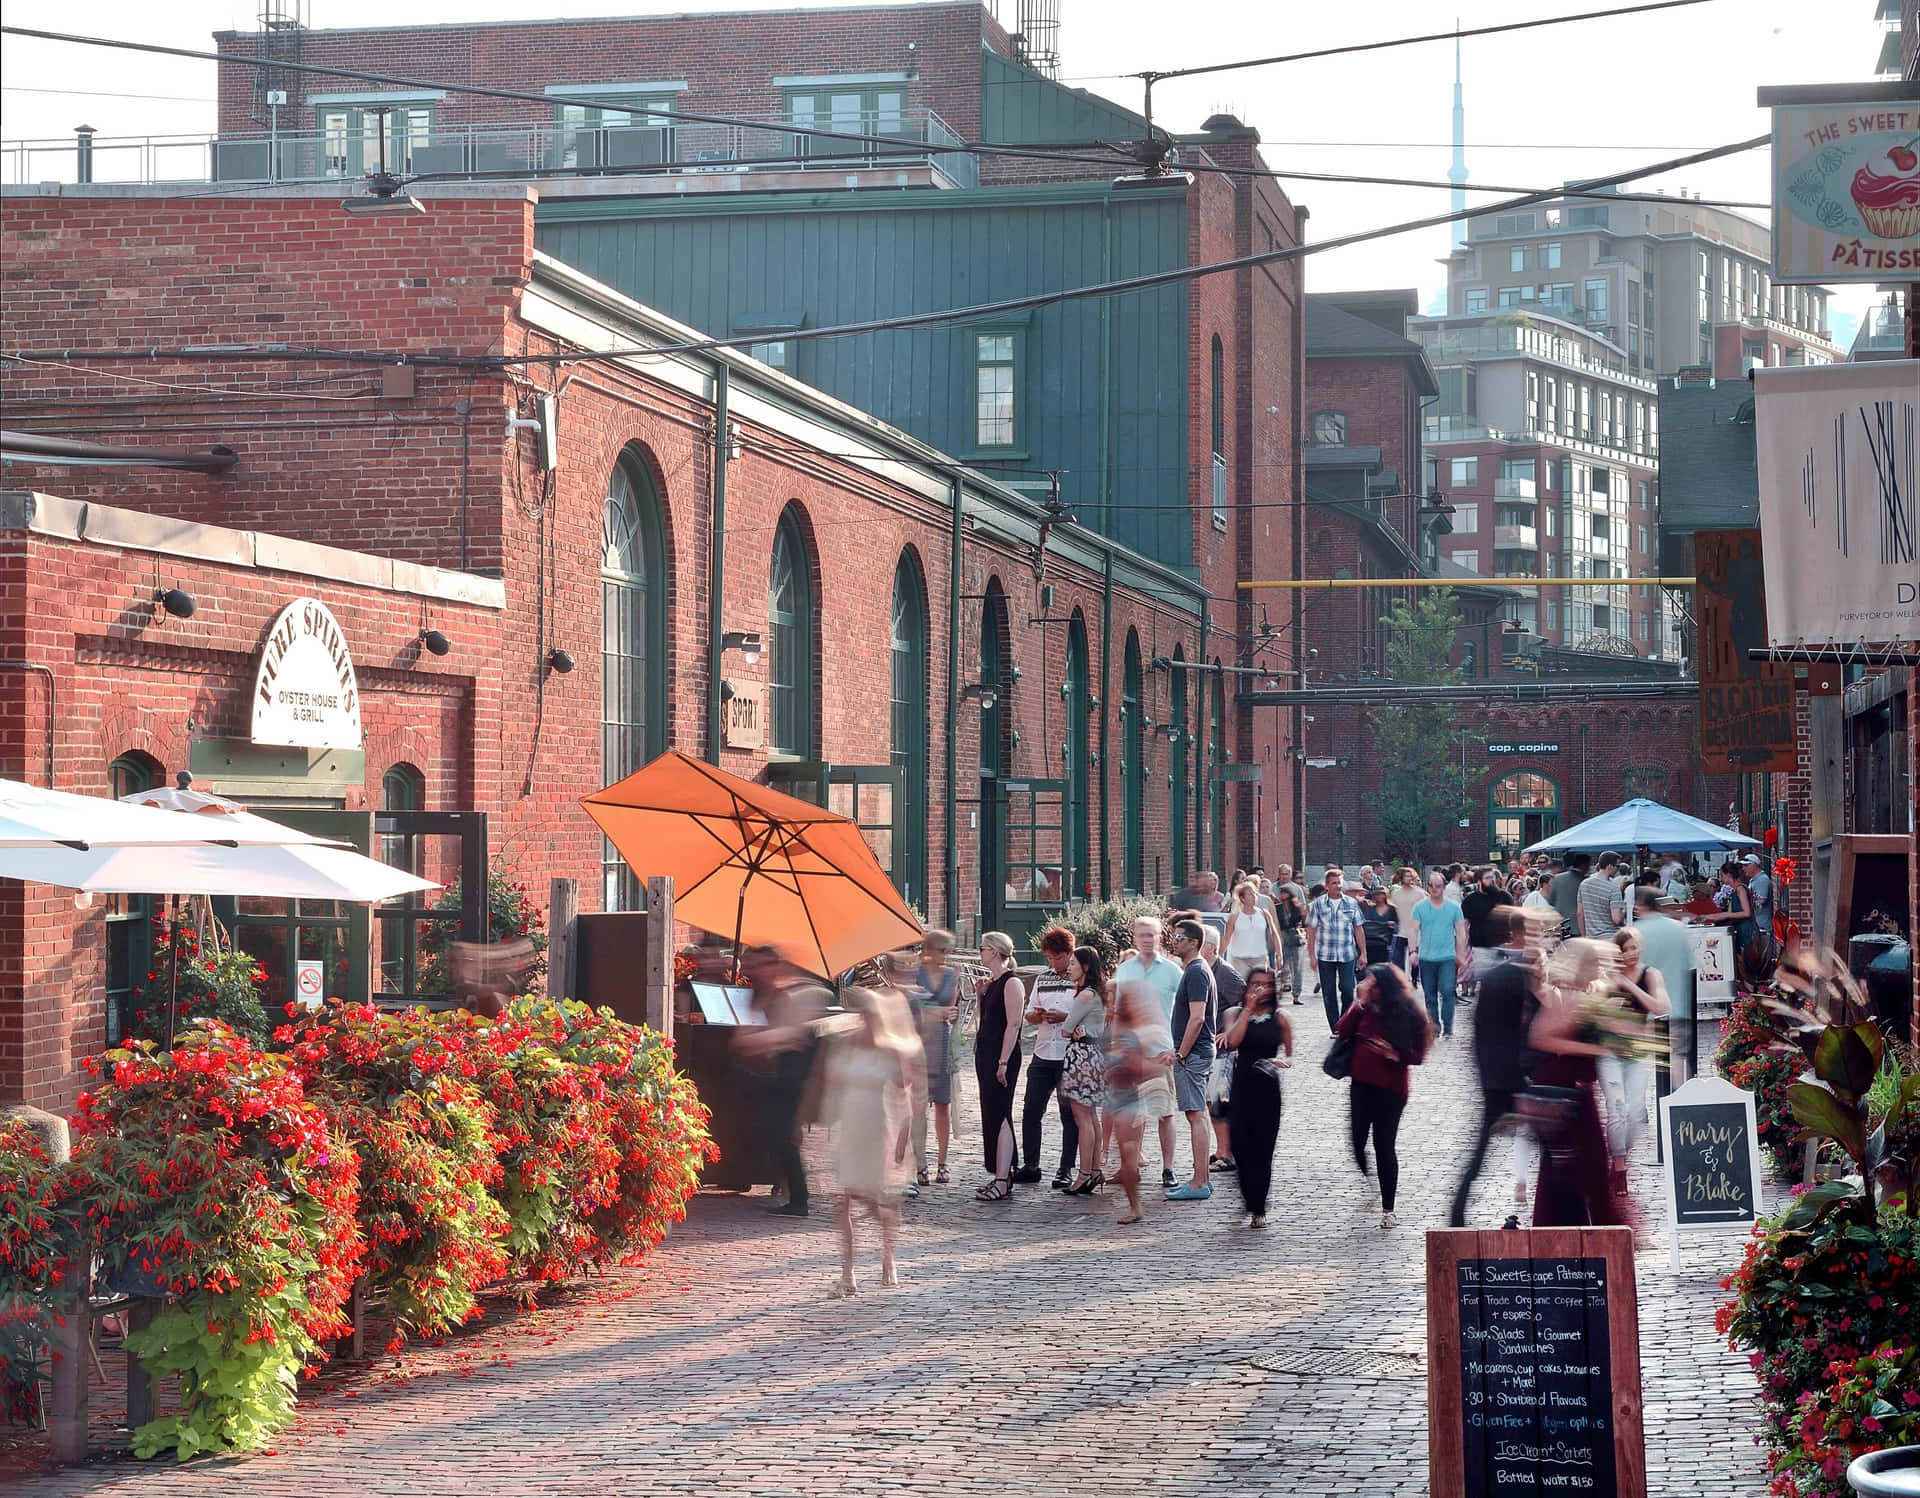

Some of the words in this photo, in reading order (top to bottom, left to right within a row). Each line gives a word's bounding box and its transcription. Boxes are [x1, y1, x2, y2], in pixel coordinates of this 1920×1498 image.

[1804, 122, 1840, 147] THE
[1848, 112, 1908, 133] SWEET
[1840, 610, 1881, 621] PURVEYOR
[260, 612, 296, 706] PURE
[304, 605, 355, 713] SPIRITS
[279, 690, 310, 706] OYSTER
[311, 693, 338, 709] HOUSE
[293, 708, 299, 720] &
[300, 708, 325, 722] GRILL
[1489, 744, 1515, 753] cop.
[1518, 743, 1559, 753] copine
[1675, 1121, 1744, 1163] Mary
[1681, 1172, 1747, 1201] Blake
[1460, 1266, 1480, 1281] The
[1484, 1294, 1510, 1306] Trade
[1543, 1327, 1582, 1342] Gourmet
[1497, 1339, 1556, 1356] Sandwiches
[1550, 1390, 1588, 1407] Flavours
[1496, 1469, 1535, 1484] Bottled
